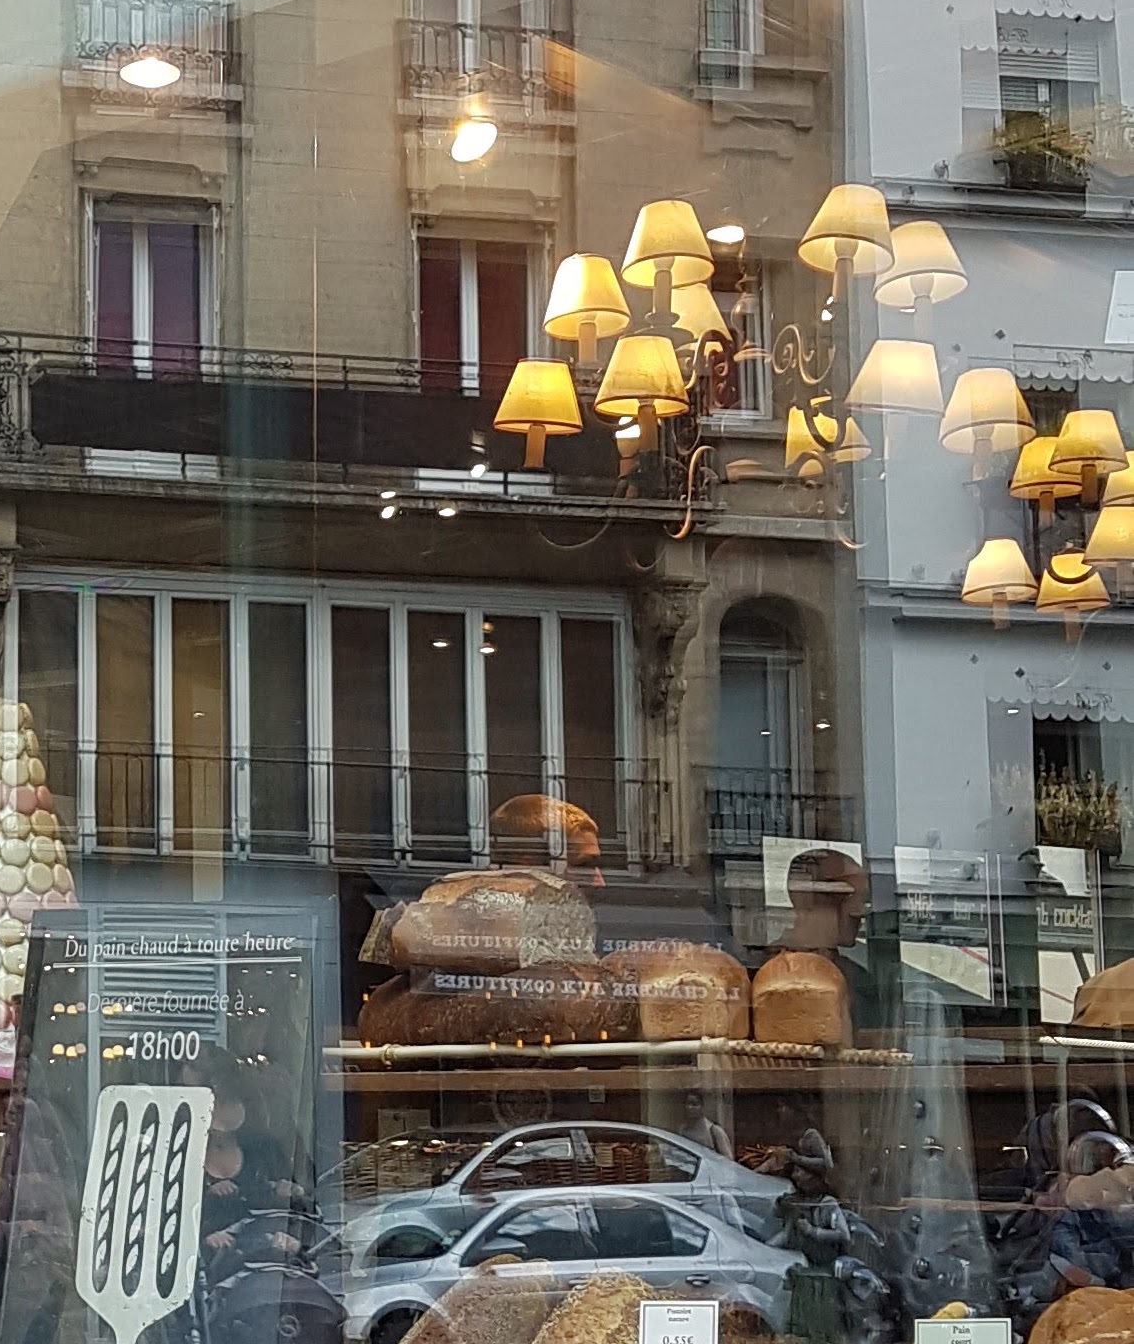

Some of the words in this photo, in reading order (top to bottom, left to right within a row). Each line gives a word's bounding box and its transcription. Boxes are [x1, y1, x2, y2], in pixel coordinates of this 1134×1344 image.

[64, 937, 88, 958] Du
[92, 936, 126, 962] pain
[130, 933, 179, 956] chaud
[182, 934, 193, 954] à
[197, 935, 240, 954] toute
[243, 931, 296, 952] heure
[87, 992, 159, 1014] Dernière
[161, 989, 230, 1014] fournée
[128, 1029, 200, 1061] 18h00
[952, 1325, 971, 1335] Pain
